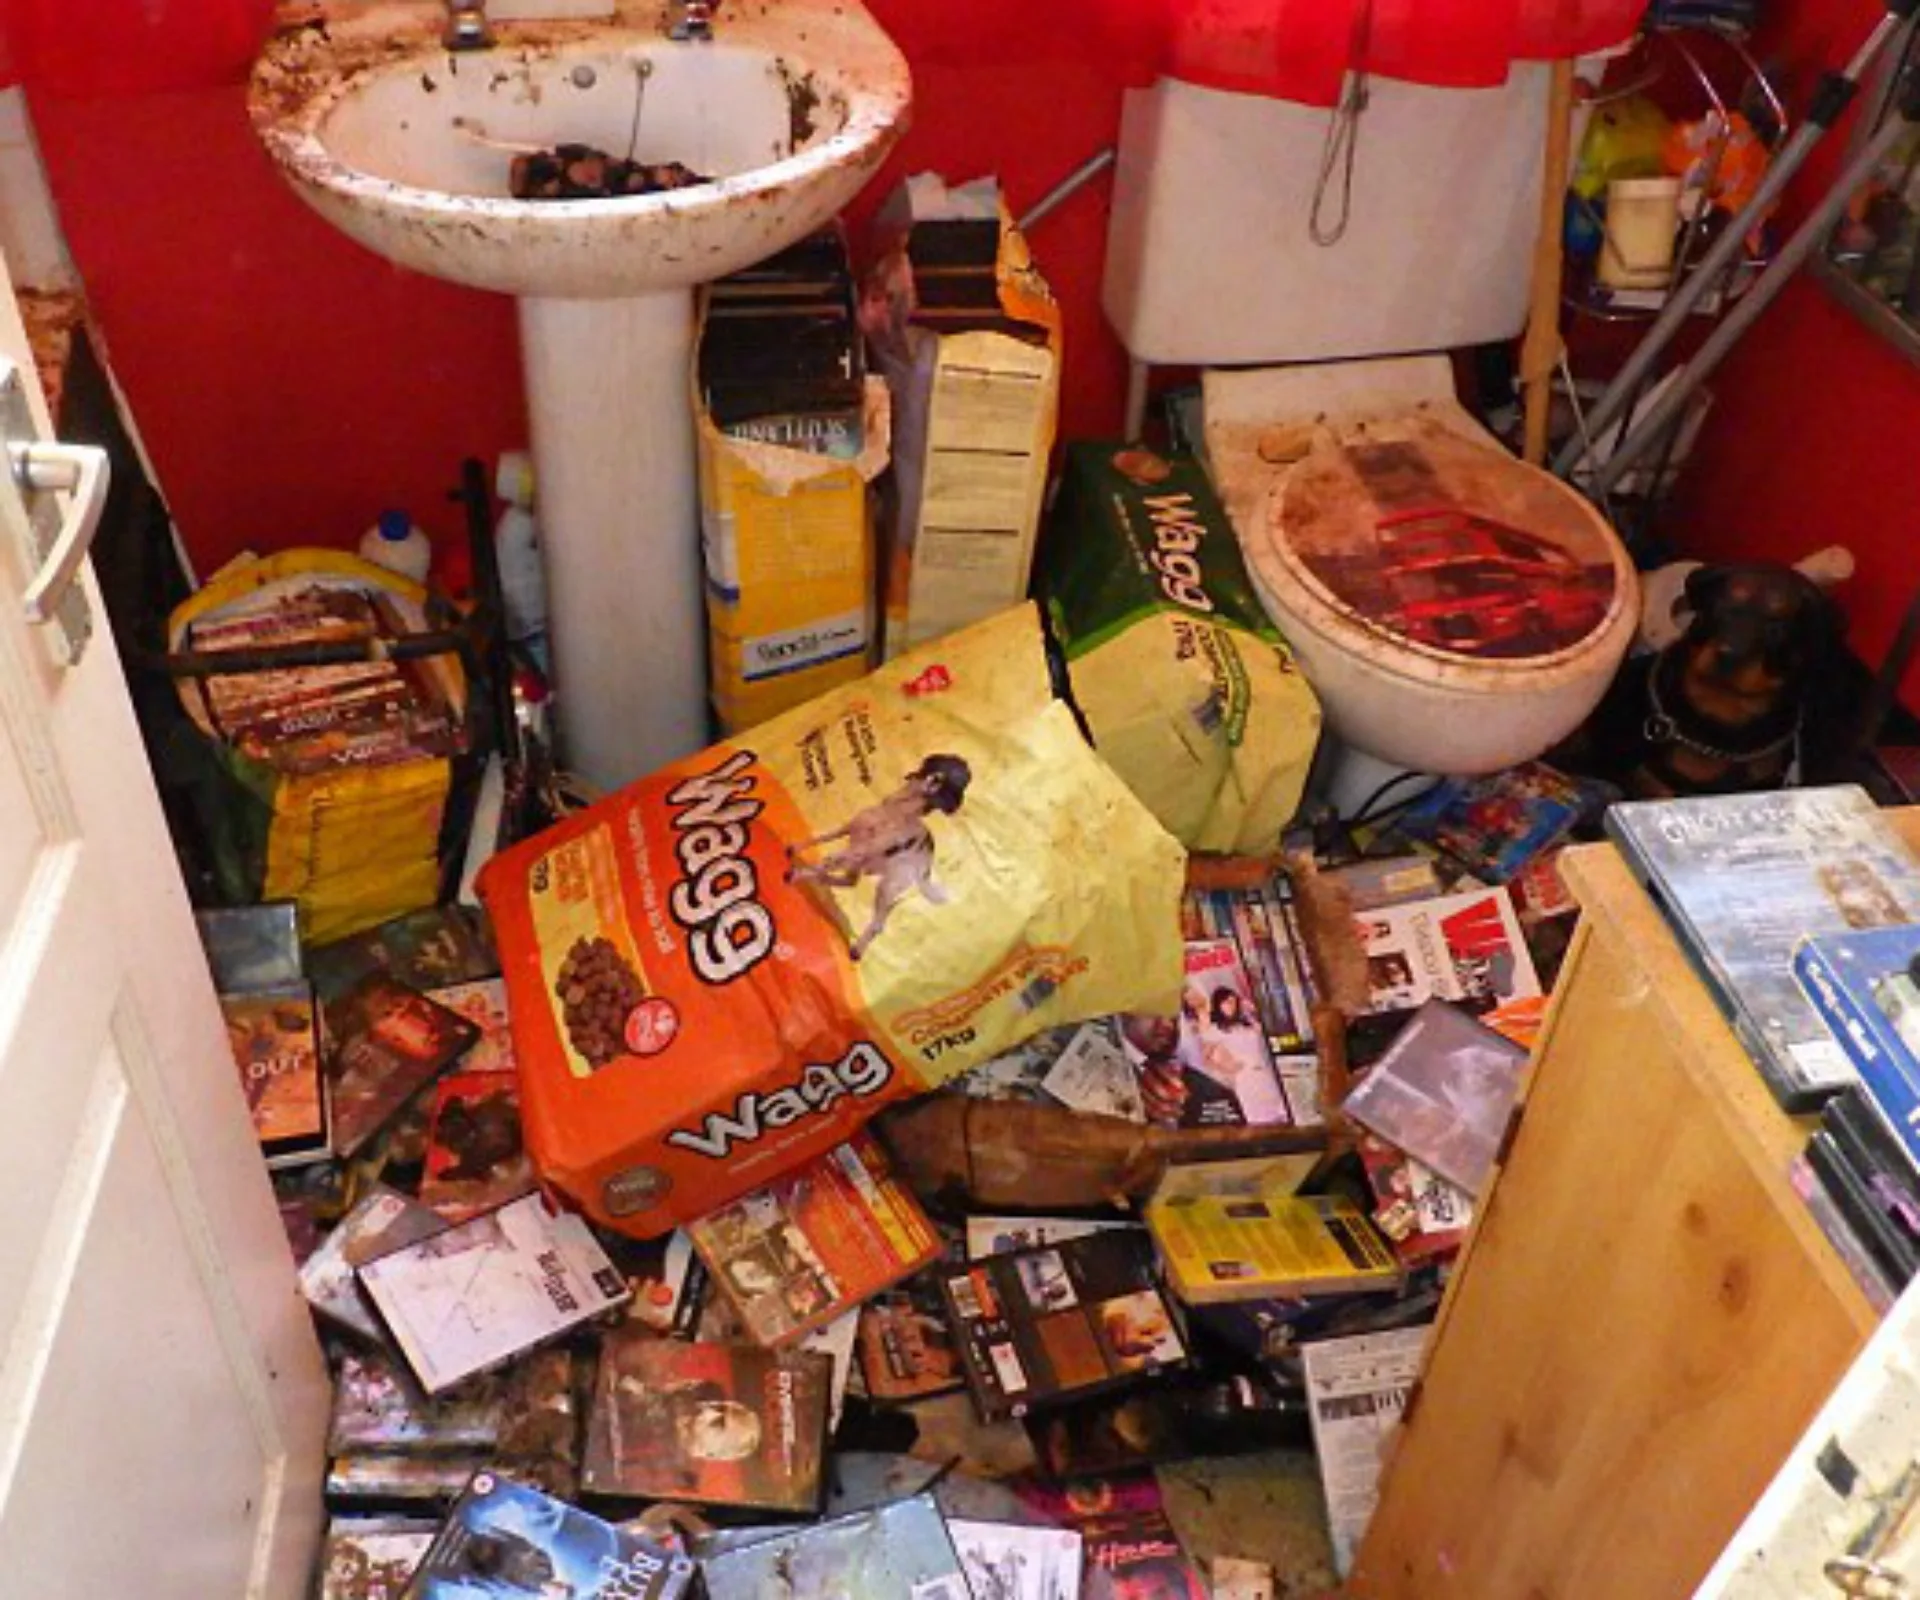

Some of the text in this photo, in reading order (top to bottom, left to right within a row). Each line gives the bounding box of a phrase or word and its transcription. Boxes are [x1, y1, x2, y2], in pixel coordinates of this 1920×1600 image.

[1143, 492, 1214, 612] Wagg
[665, 748, 776, 983] Wagg
[664, 1040, 894, 1159] Wagg
[919, 1026, 977, 1061] 17kg
